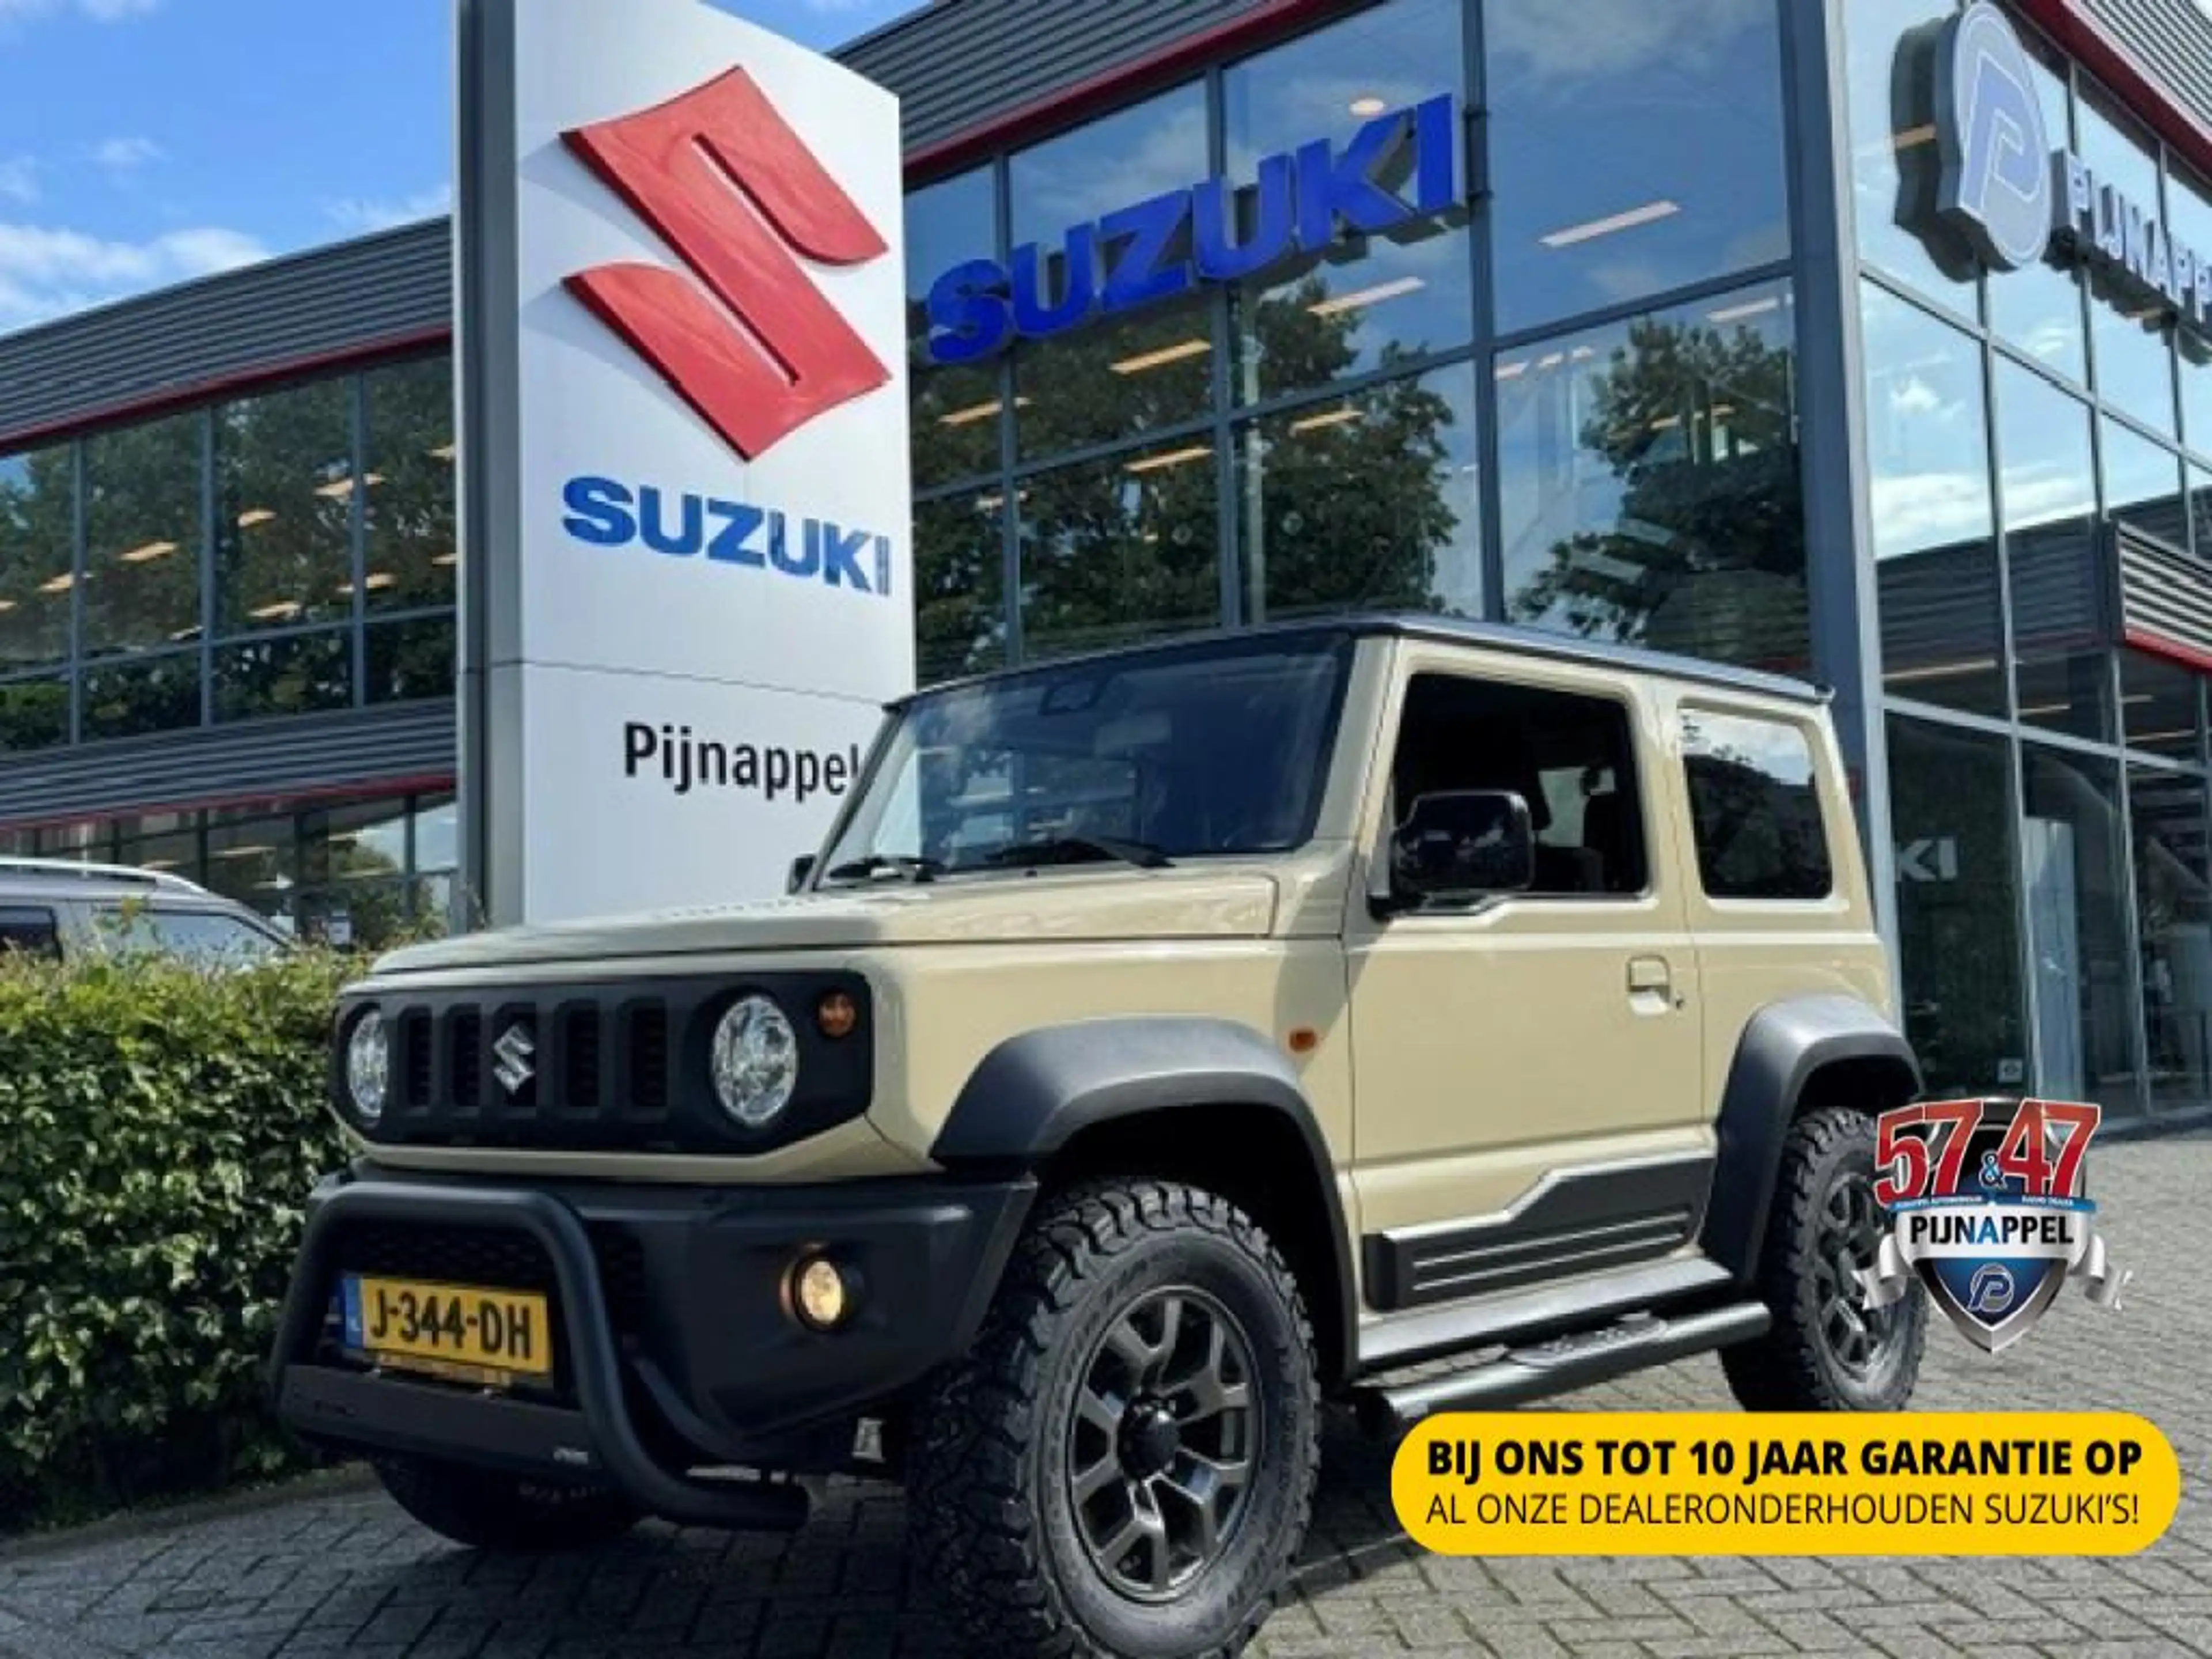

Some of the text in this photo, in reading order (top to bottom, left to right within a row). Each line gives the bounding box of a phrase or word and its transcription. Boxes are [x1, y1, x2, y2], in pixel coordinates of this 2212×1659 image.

[928, 93, 1452, 364] SUZUKI
[561, 476, 890, 595] SUZUKI
[624, 721, 859, 802] Pijnappel
[370, 1288, 531, 1361] J-344-DH
